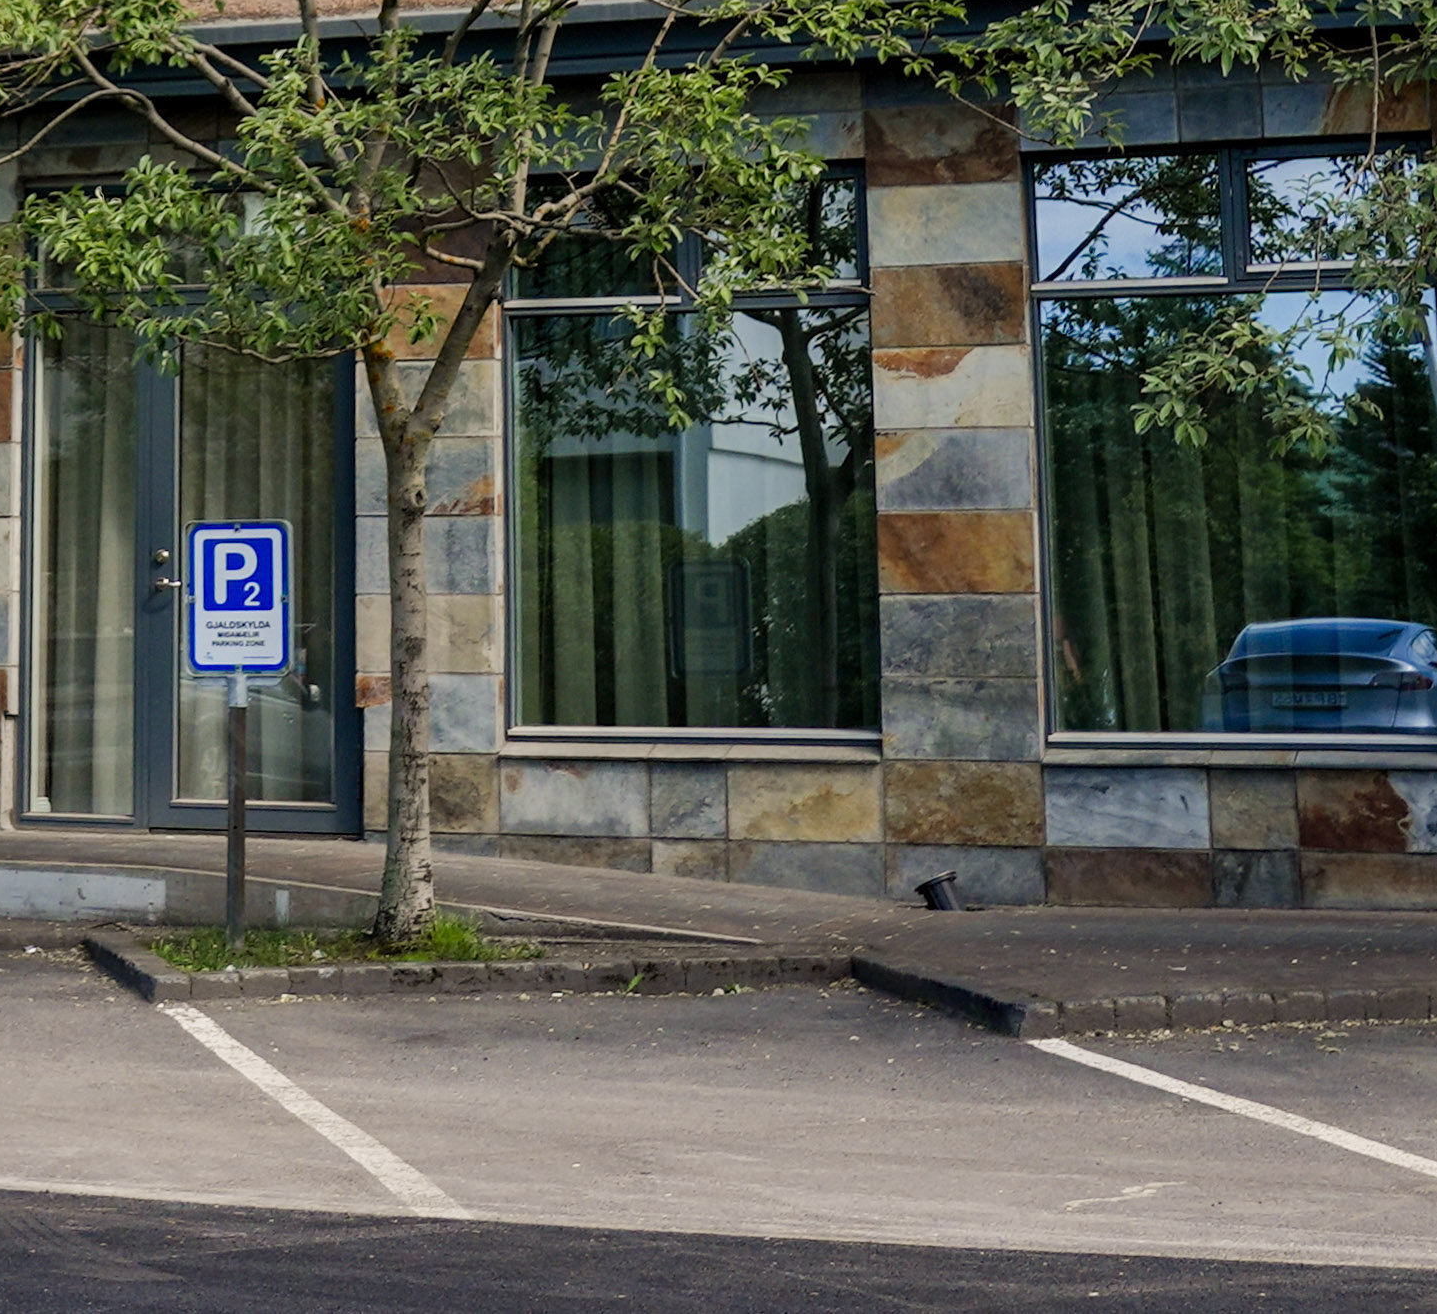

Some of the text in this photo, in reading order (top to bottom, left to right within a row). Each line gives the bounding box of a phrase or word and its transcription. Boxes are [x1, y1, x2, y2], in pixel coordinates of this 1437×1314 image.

[205, 620, 272, 630] GJALDSKYLDA
[211, 640, 266, 648] PARKING ZONE
